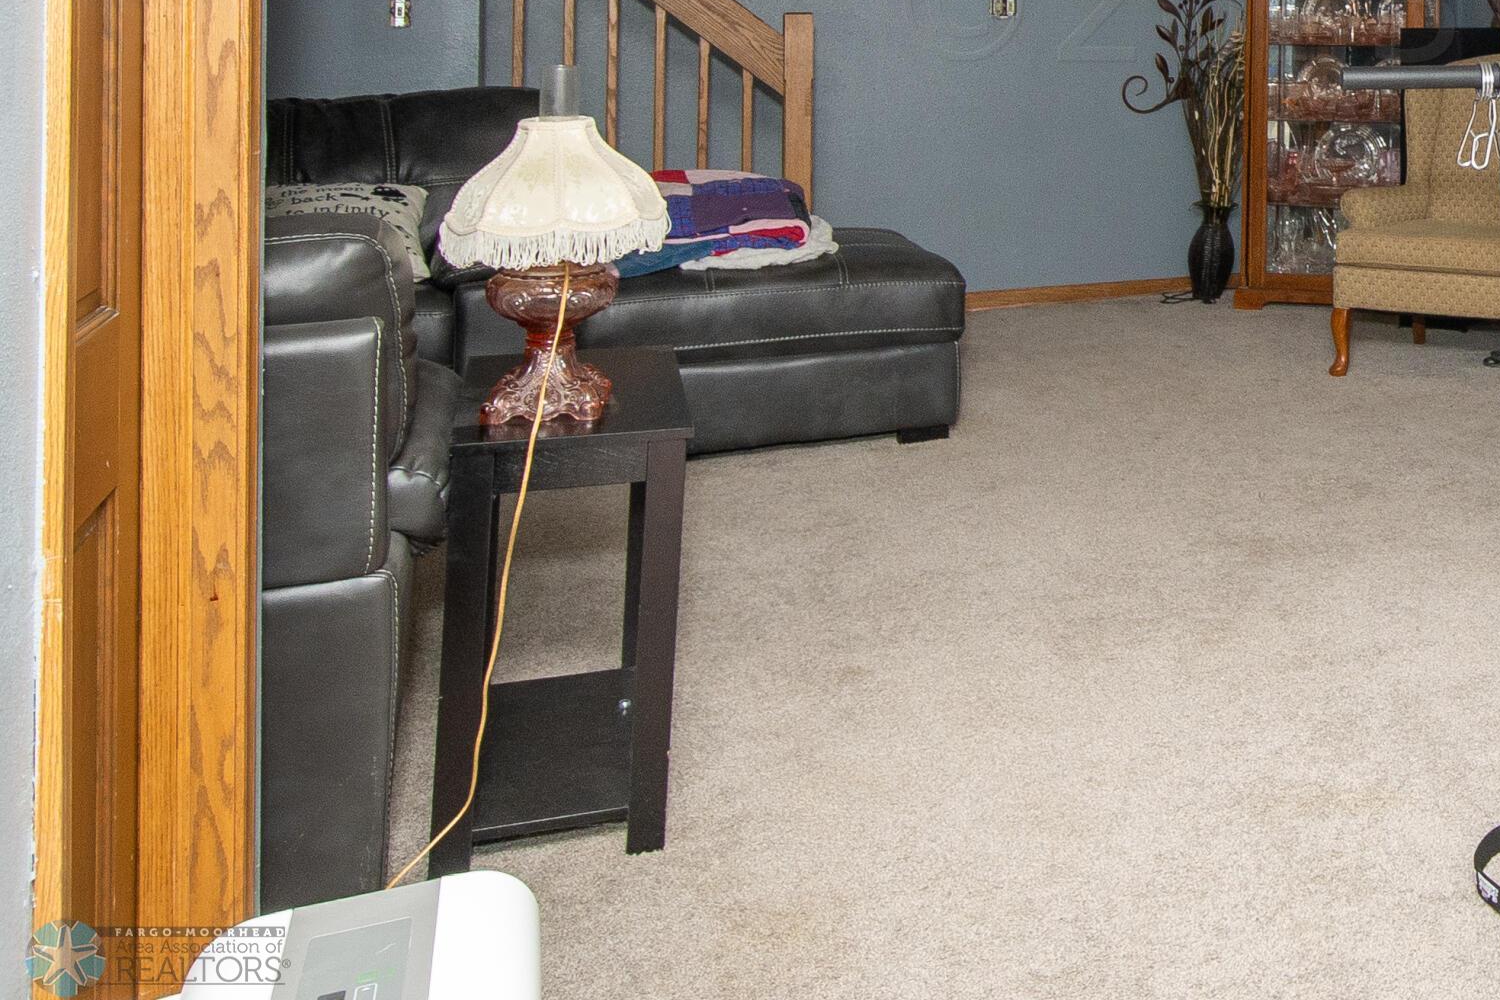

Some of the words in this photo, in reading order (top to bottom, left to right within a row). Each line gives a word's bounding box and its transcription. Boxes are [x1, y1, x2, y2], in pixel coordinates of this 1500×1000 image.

[281, 186, 308, 198] the
[315, 185, 365, 193] moon
[291, 193, 338, 204] back
[313, 203, 390, 220] infinity
